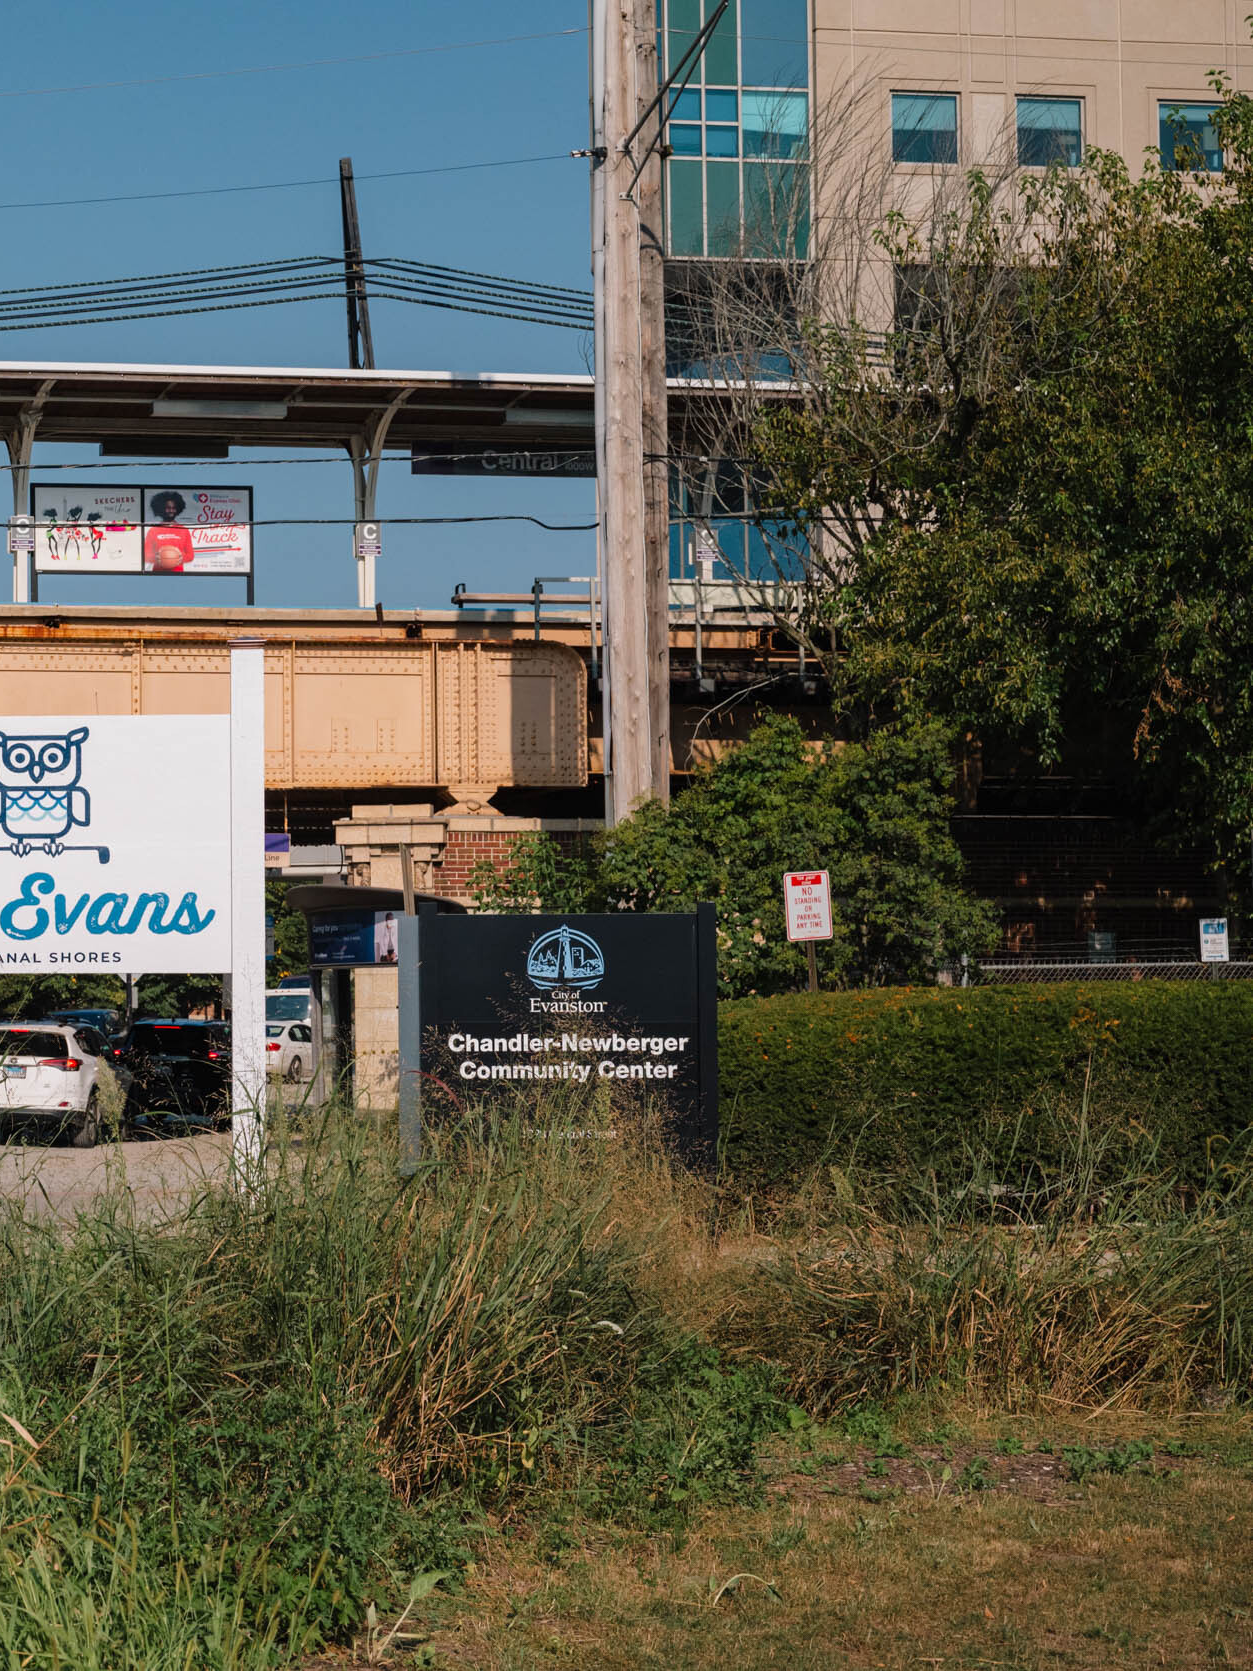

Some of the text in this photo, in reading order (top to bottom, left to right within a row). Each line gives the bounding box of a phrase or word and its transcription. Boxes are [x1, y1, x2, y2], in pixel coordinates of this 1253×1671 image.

[482, 450, 558, 471] Central
[94, 496, 135, 505] SKECHERS
[197, 505, 234, 523] Stay
[192, 526, 242, 544] Track
[363, 523, 377, 540] C
[802, 887, 812, 896] NO
[0, 871, 216, 941] Evans
[49, 951, 122, 964] SHORES
[551, 990, 580, 1001] City of
[529, 997, 605, 1013] Evanston
[448, 1033, 689, 1056] Chandler-Newberger
[460, 1060, 678, 1083] Community Center
